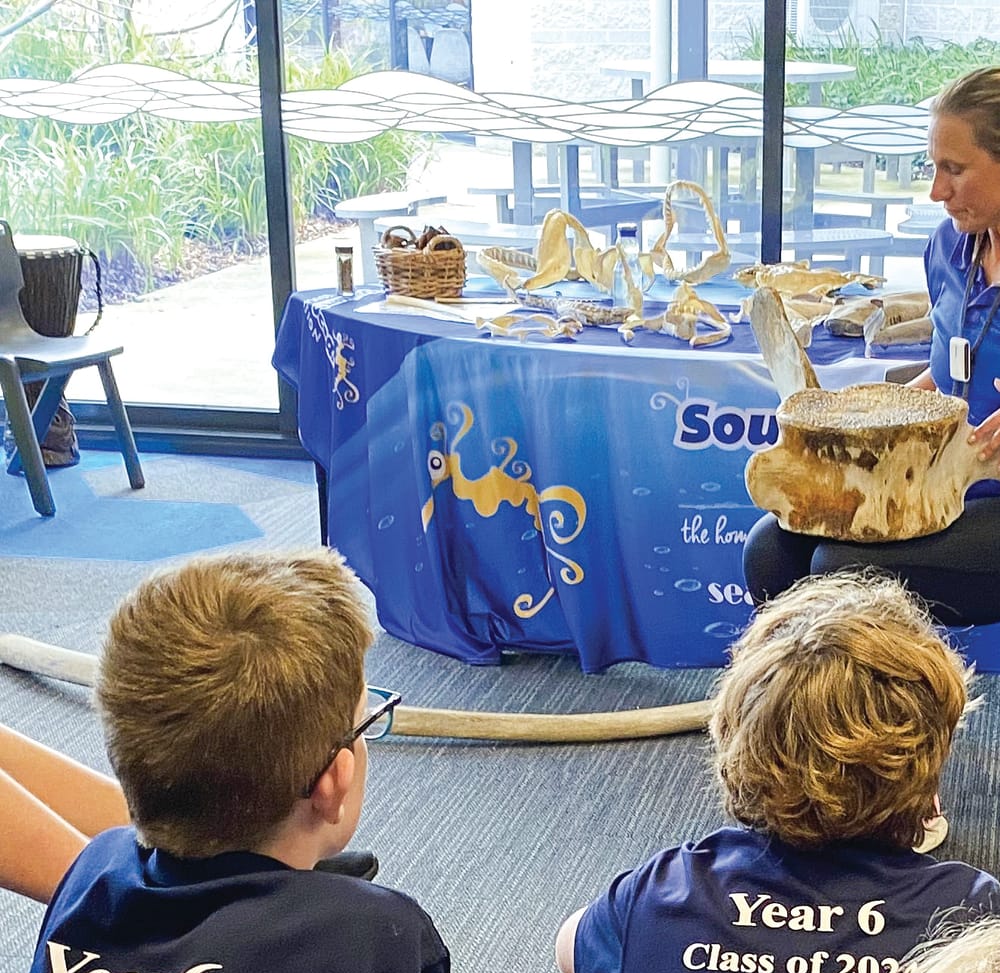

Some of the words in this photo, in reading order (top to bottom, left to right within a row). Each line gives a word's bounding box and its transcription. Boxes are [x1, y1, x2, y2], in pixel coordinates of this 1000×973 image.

[677, 401, 781, 449] Sou
[681, 515, 710, 544] the
[729, 892, 844, 933] Year
[857, 899, 886, 936] 6
